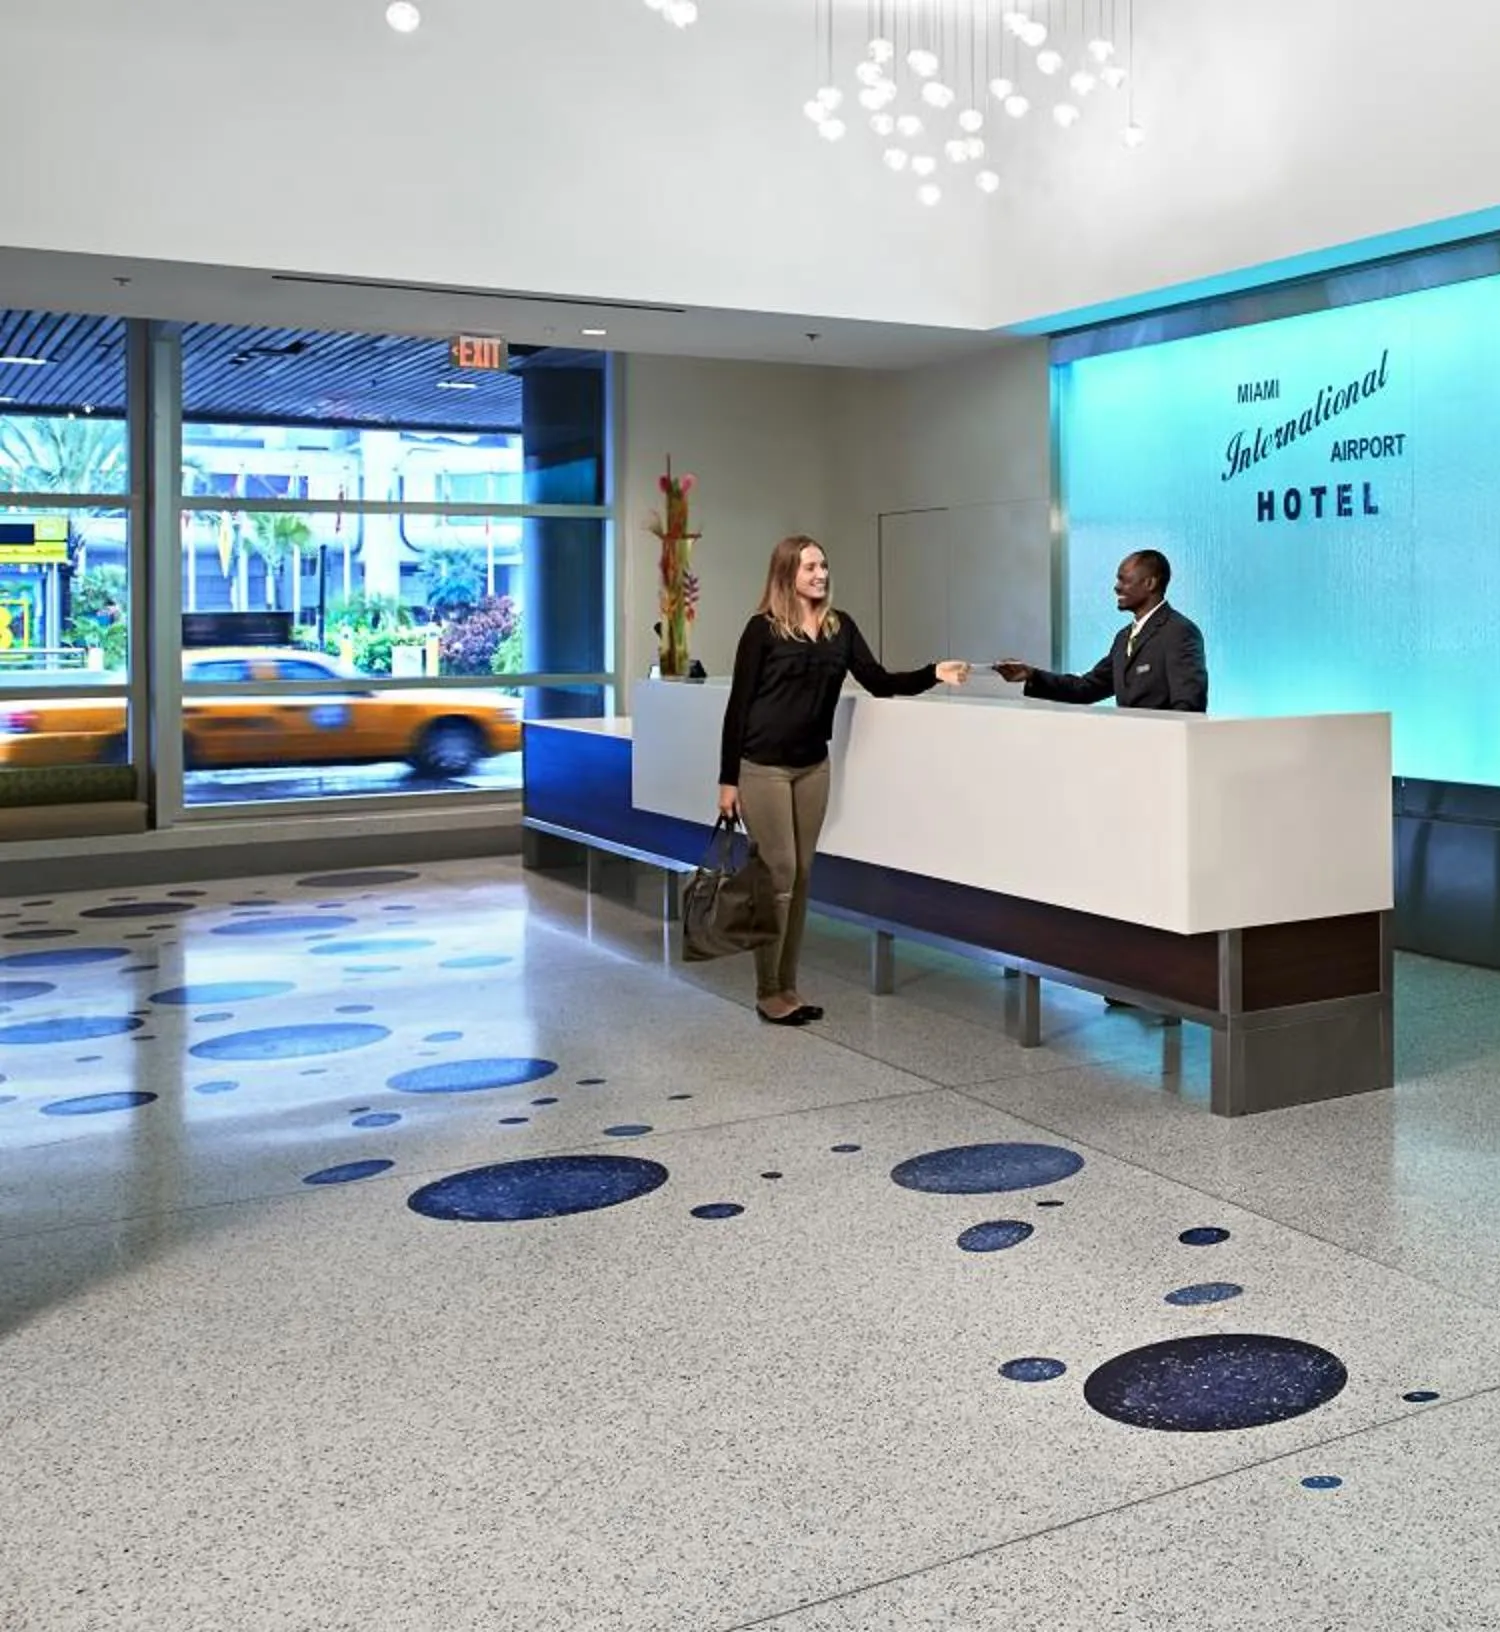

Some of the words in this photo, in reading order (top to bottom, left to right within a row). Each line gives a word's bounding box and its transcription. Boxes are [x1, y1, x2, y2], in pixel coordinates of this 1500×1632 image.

[460, 336, 500, 368] EXIT
[1237, 379, 1280, 404] MIAMI
[1221, 349, 1388, 482] International
[1330, 434, 1406, 462] AIRPORT
[1257, 482, 1379, 522] HOTEL
